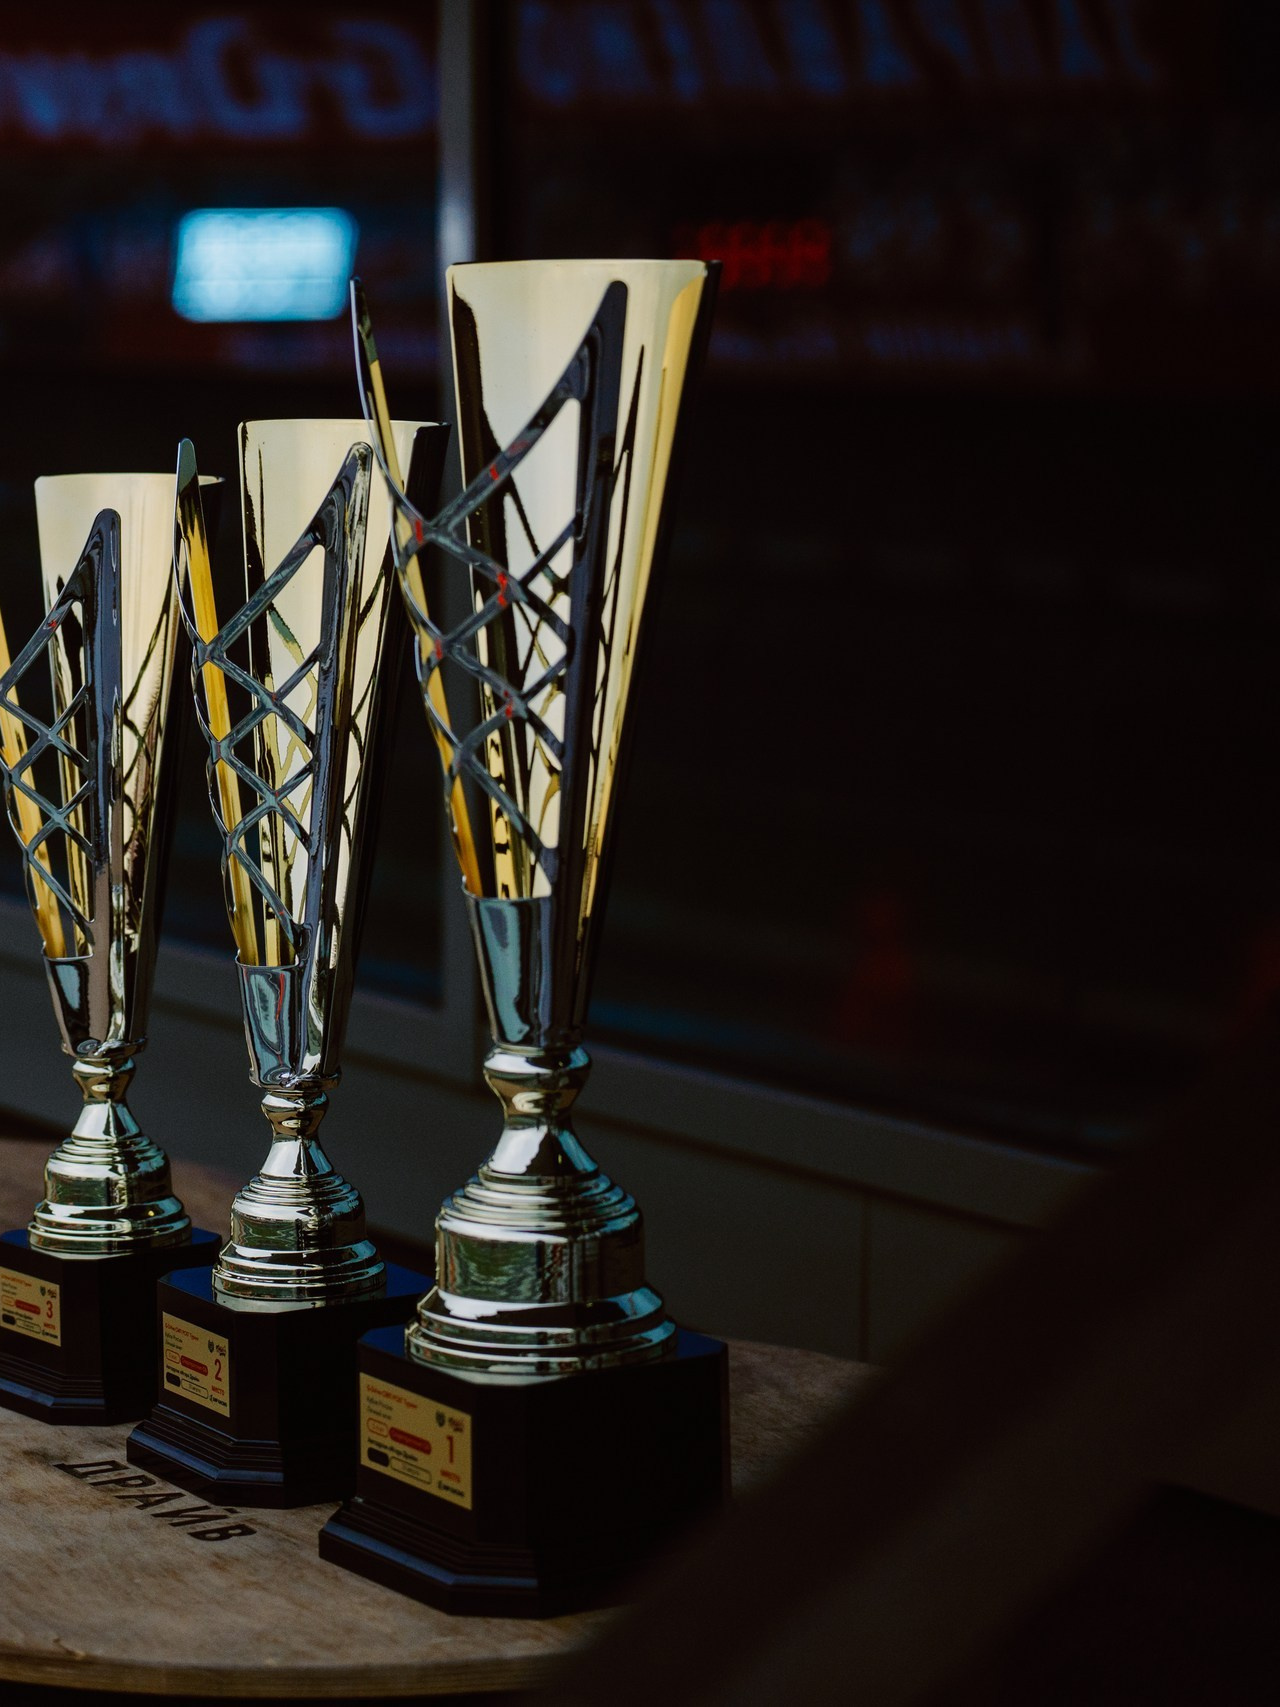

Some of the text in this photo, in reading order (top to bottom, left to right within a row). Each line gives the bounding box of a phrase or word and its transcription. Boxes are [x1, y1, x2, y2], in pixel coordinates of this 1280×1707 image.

[46, 1300, 53, 1319] 3
[214, 1358, 222, 1382] 2
[446, 1434, 454, 1463] 1
[53, 1460, 257, 1542] ДРАЙВ
